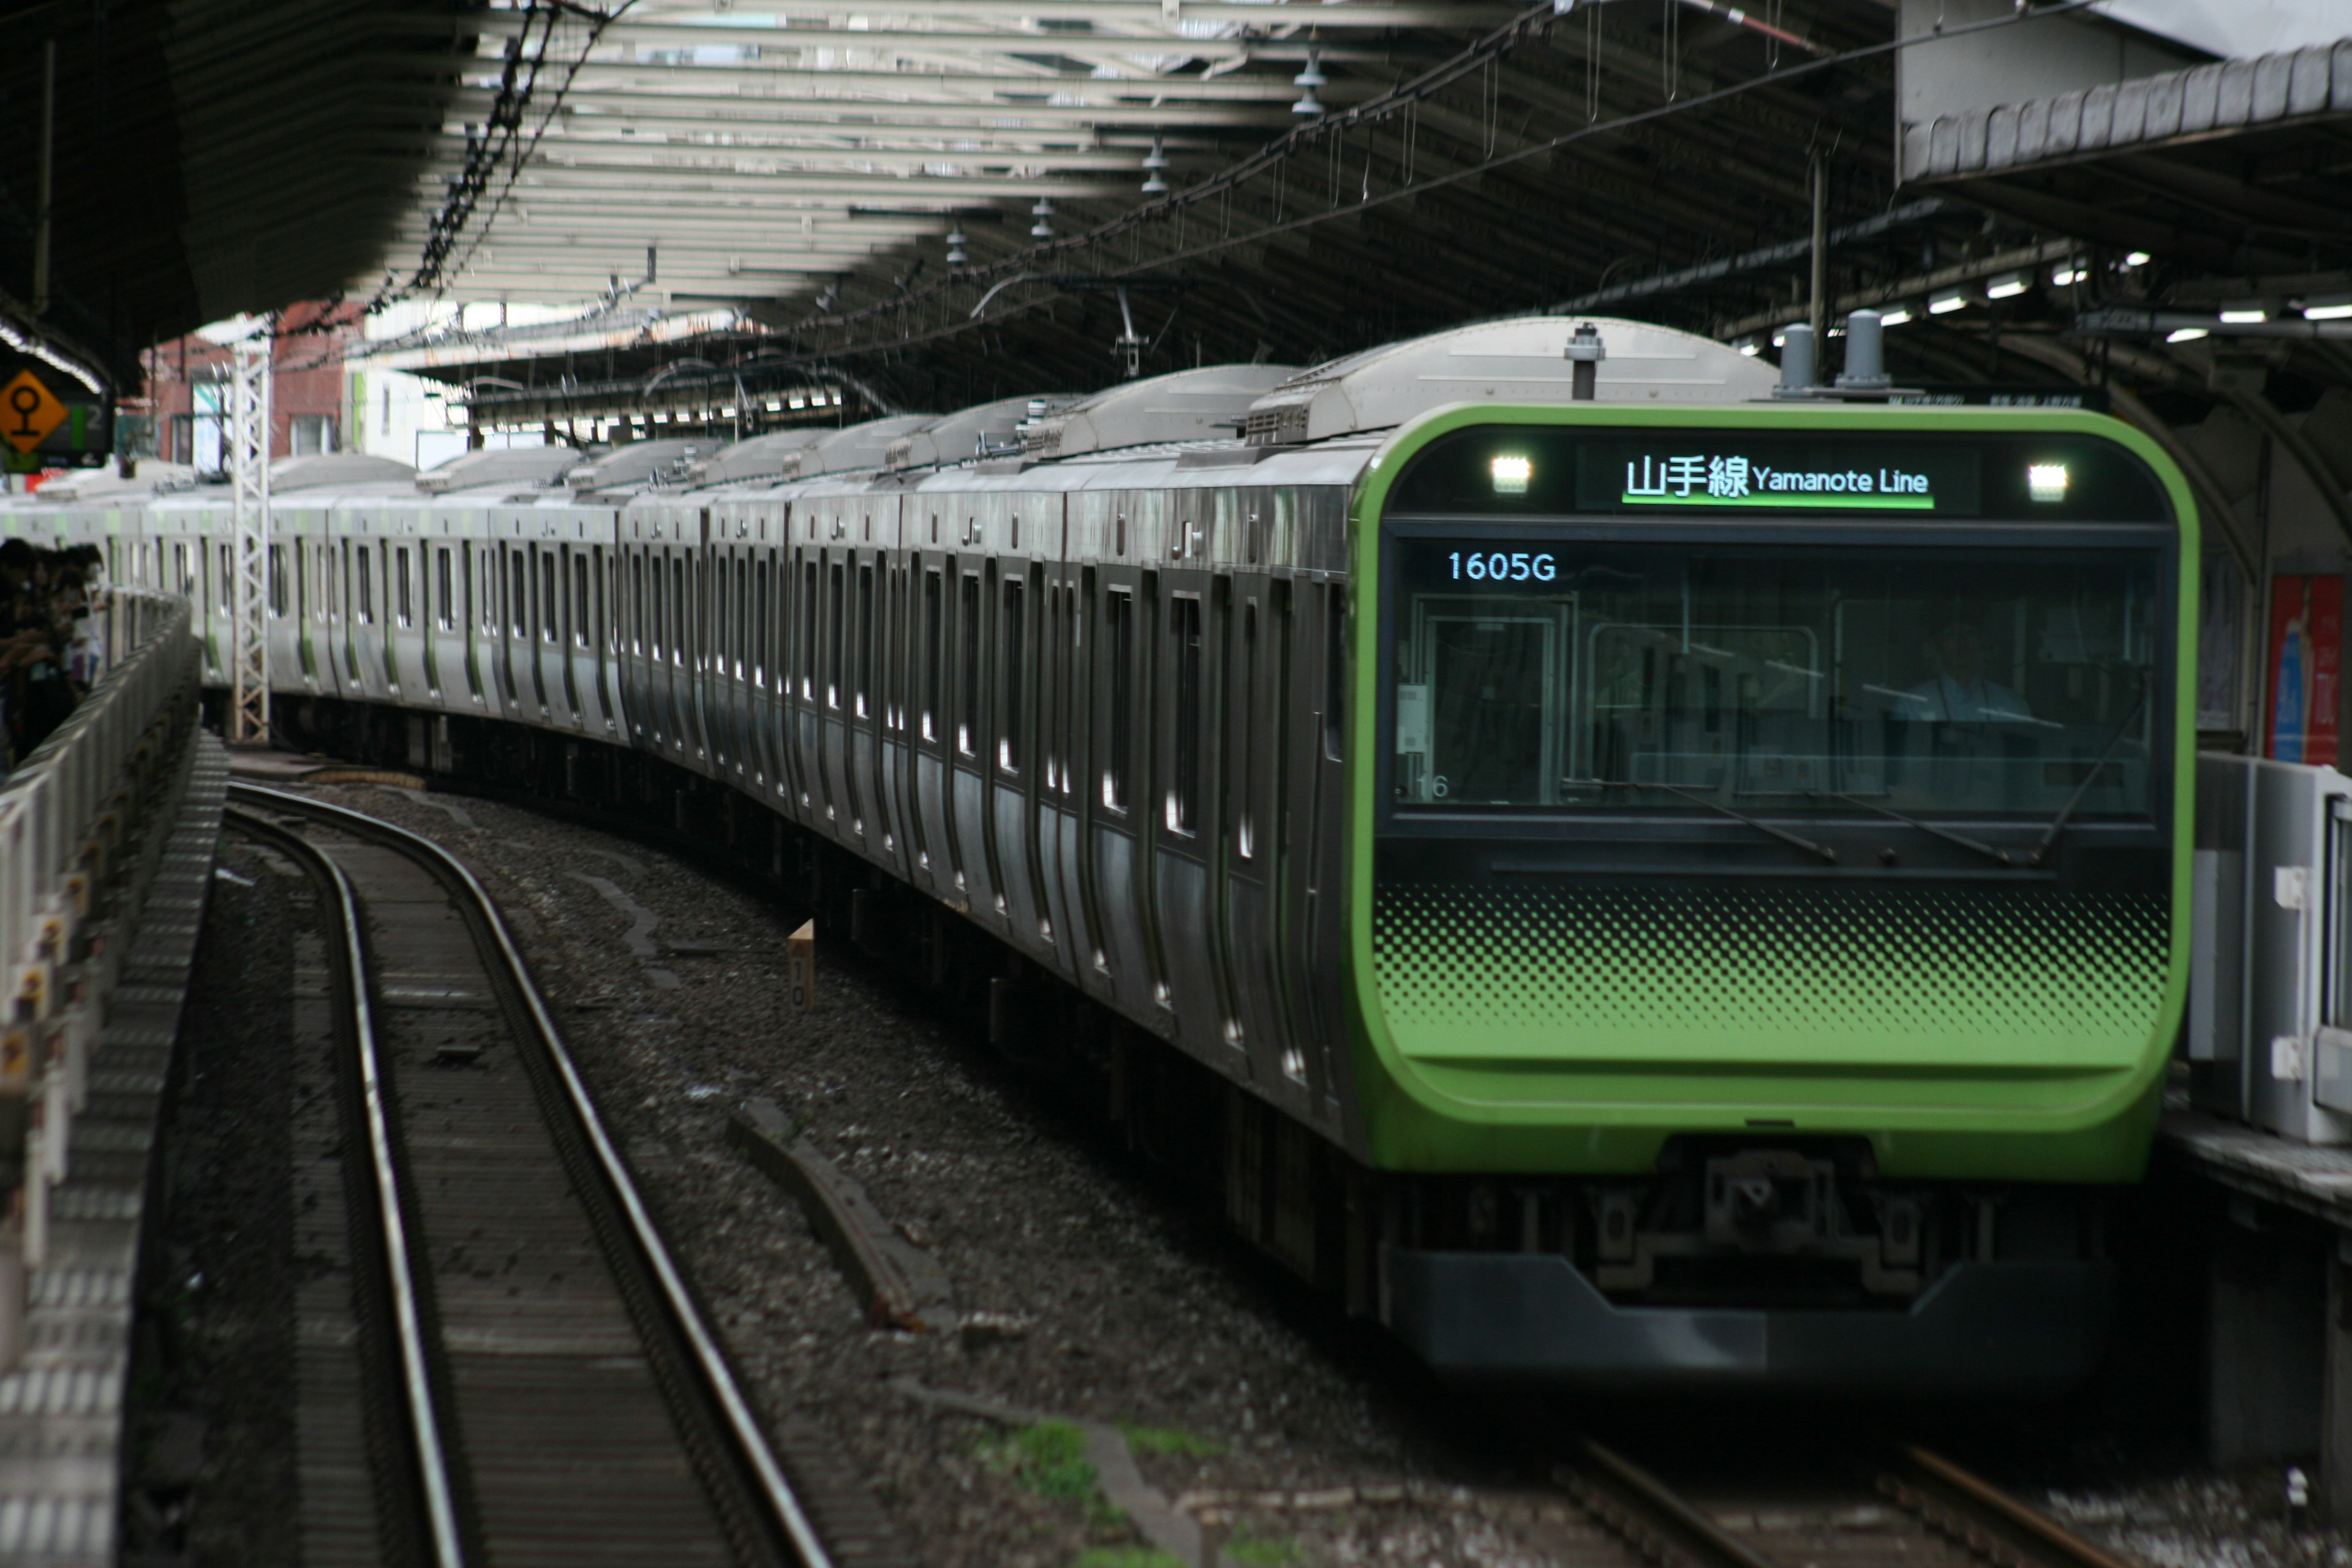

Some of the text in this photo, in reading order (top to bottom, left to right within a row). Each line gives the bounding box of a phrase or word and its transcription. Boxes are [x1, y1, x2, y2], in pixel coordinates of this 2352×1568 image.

[86, 405, 103, 430] 2
[1627, 455, 1750, 497] 山手線
[1752, 467, 1929, 494] Yamanote Line
[1449, 552, 1556, 581] 1605G
[1417, 775, 1449, 798] 16
